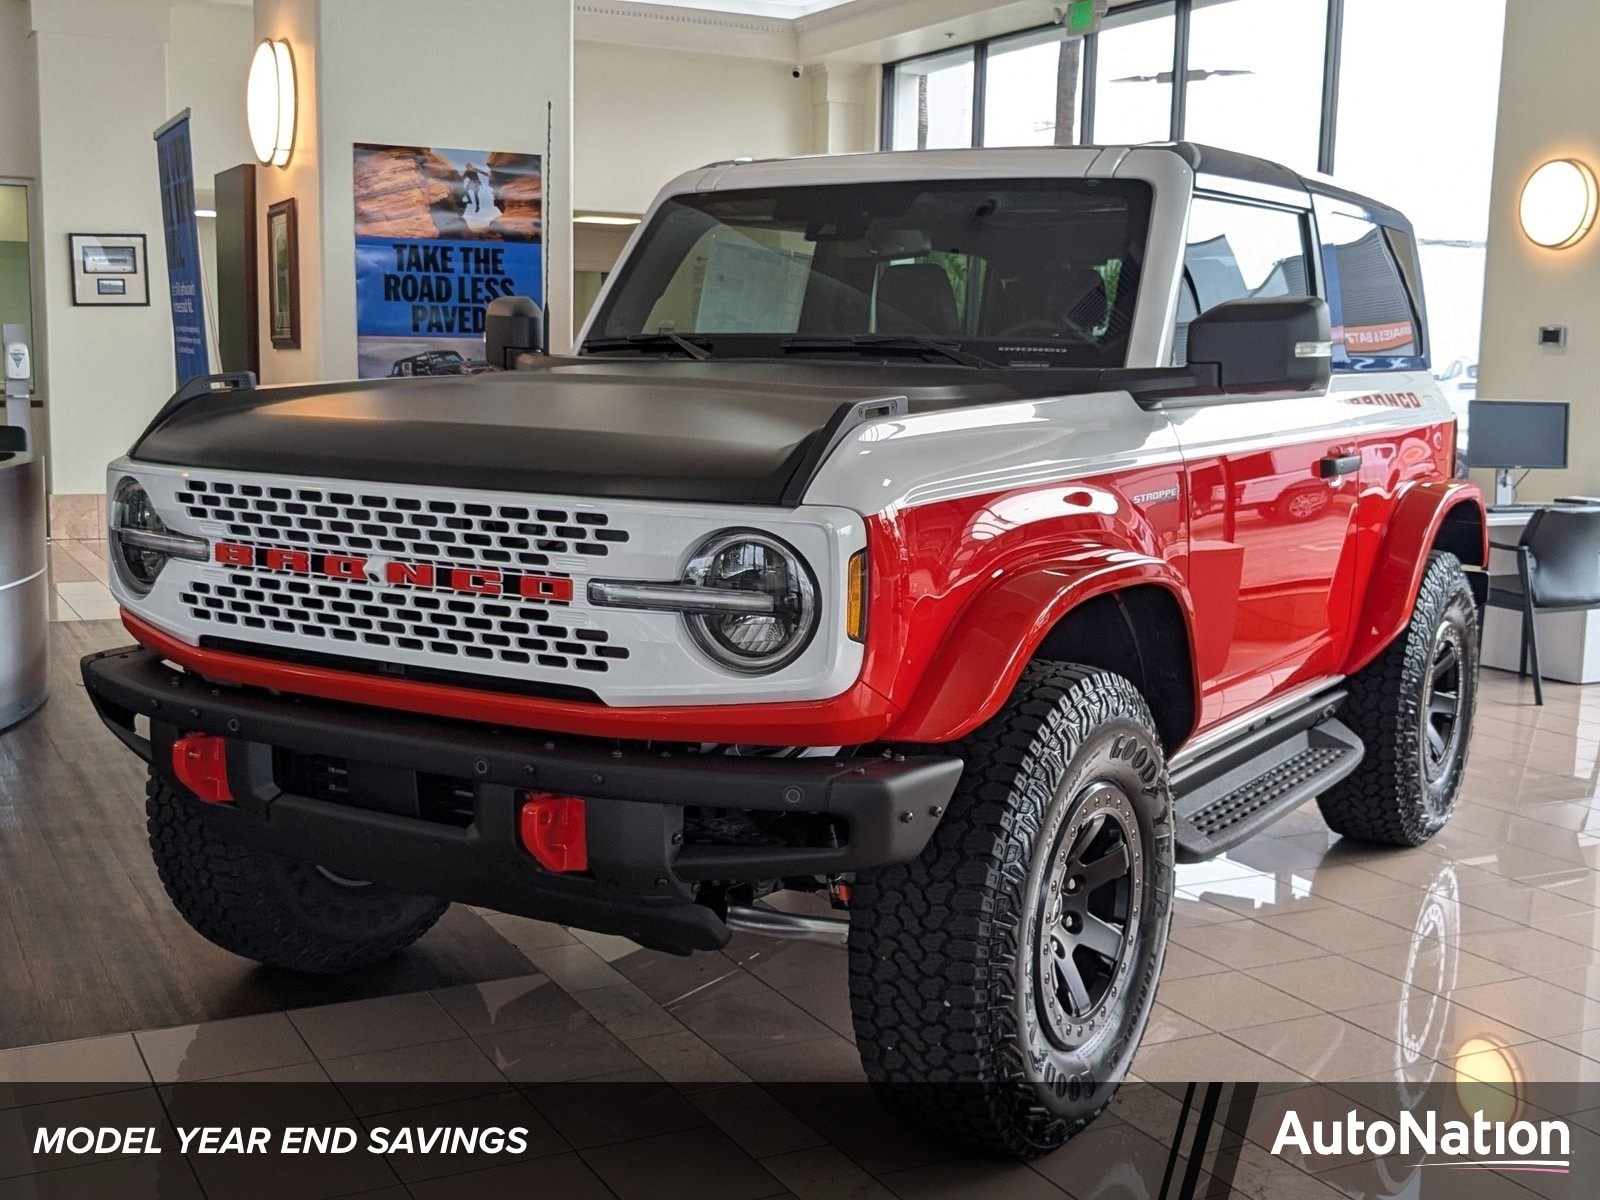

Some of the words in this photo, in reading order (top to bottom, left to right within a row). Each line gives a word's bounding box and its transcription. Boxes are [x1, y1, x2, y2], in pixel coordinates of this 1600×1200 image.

[392, 244, 455, 274] TAKE
[459, 246, 506, 276] THE
[383, 274, 454, 303] ROAD
[458, 277, 516, 305] LESS
[411, 304, 487, 334] PAVED
[1132, 487, 1178, 505] STROPPE
[214, 542, 574, 603] BRONCO
